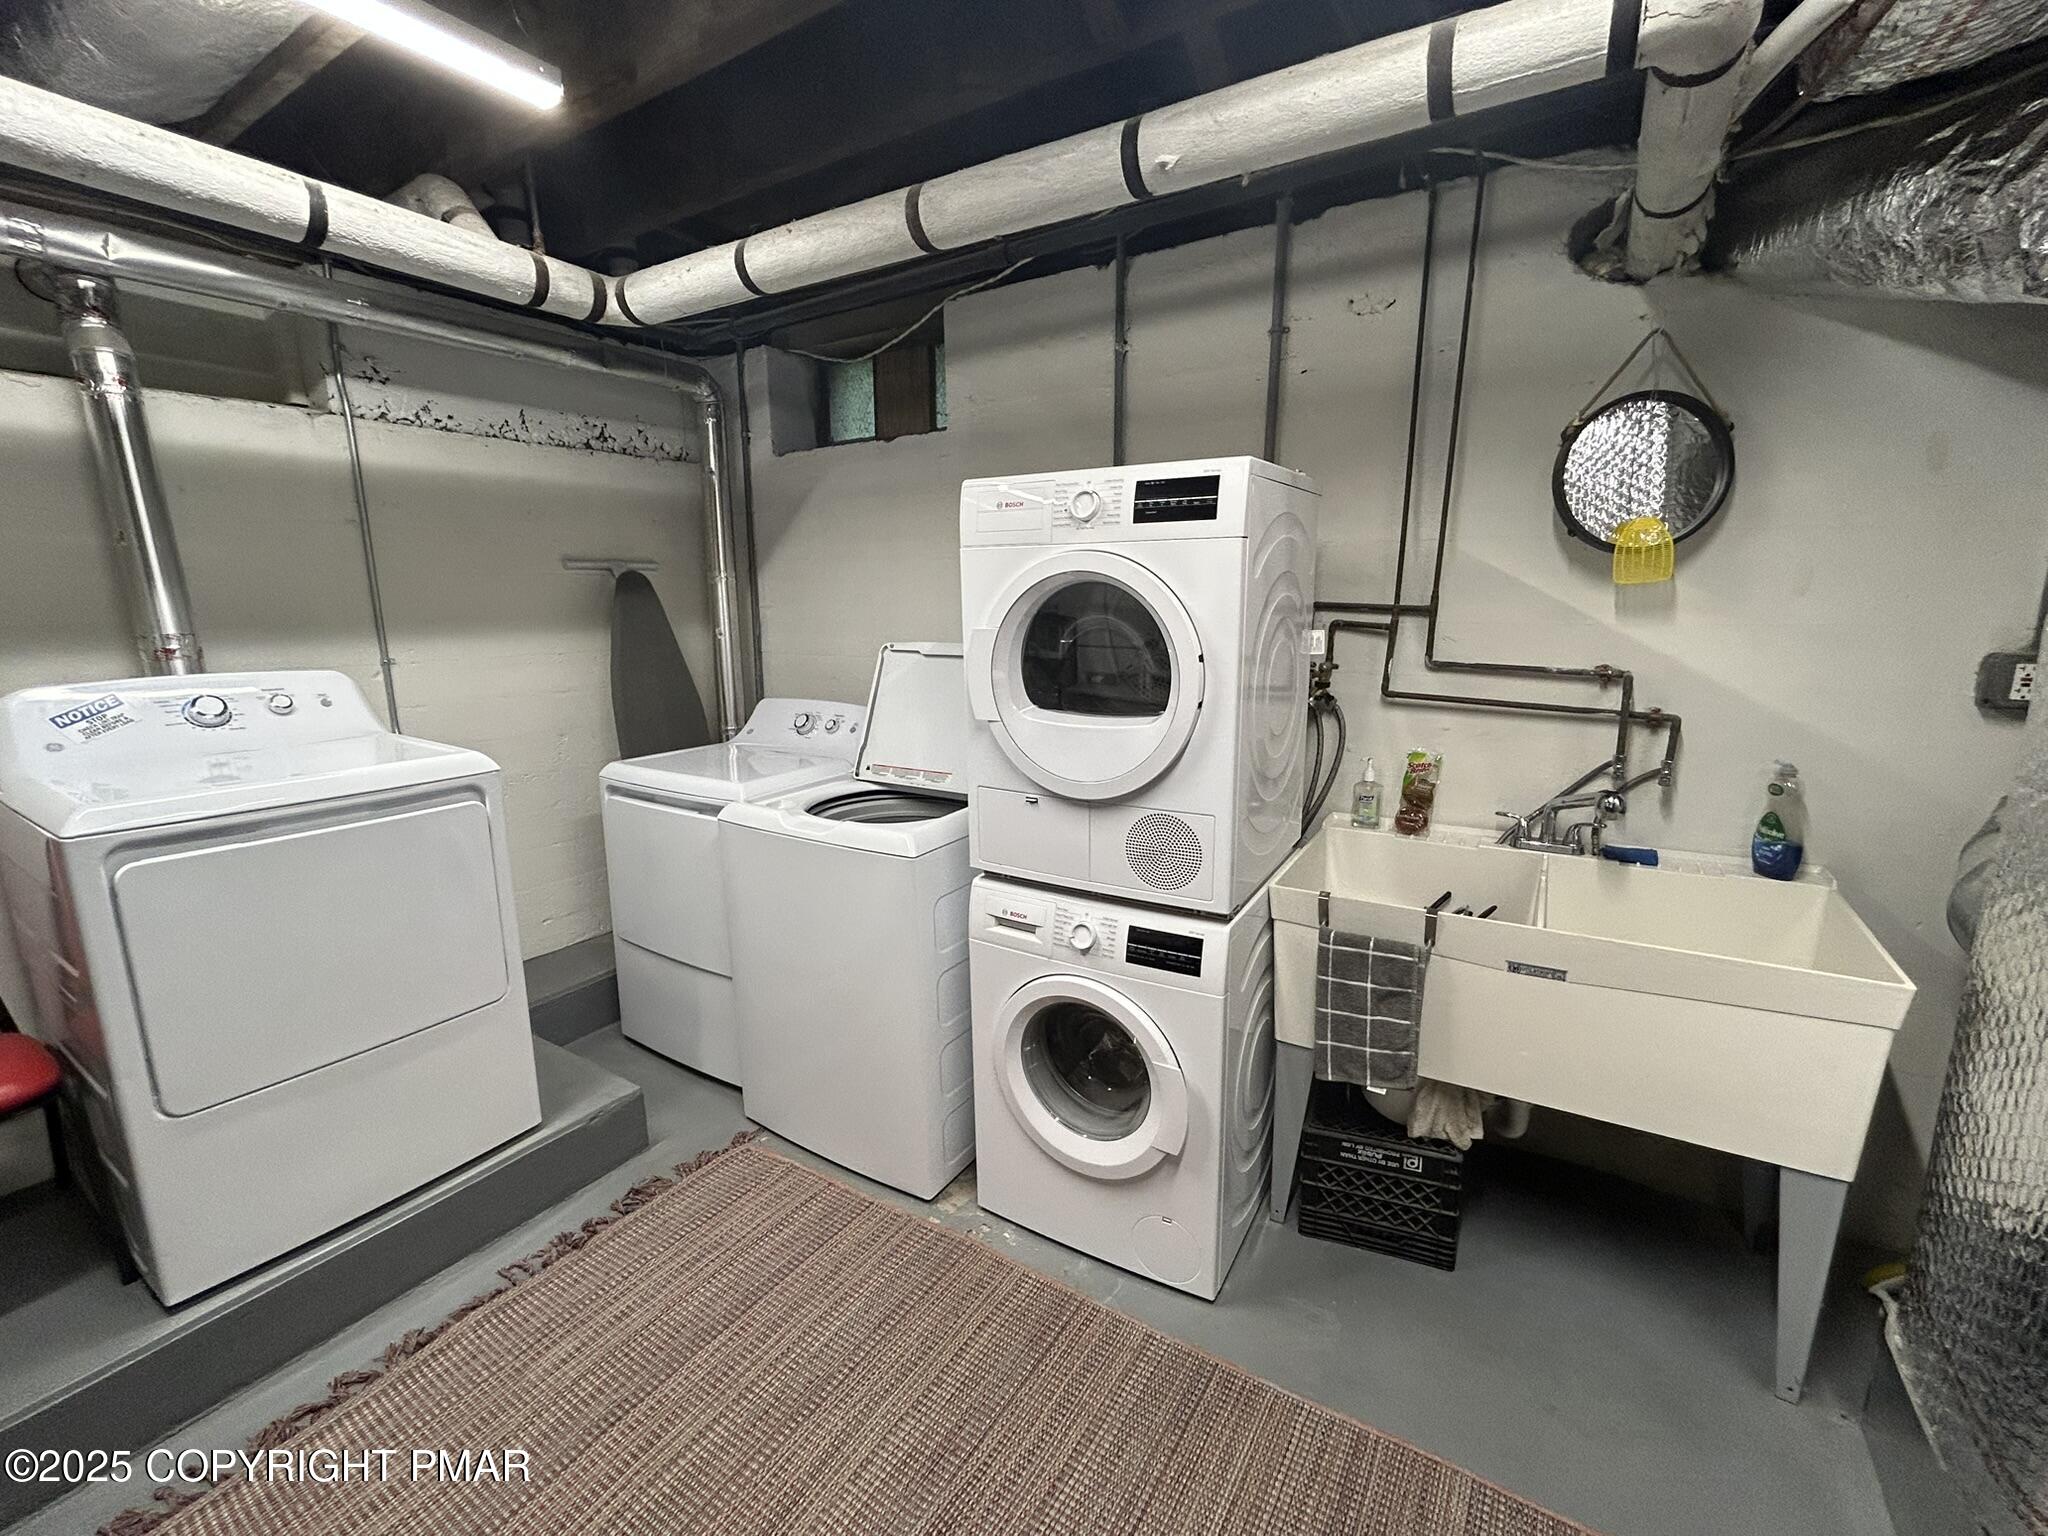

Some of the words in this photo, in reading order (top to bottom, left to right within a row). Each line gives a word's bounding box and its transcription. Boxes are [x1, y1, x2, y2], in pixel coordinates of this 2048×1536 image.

[54, 695, 119, 727] NOTICE
[85, 713, 108, 725] STOP
[1010, 911, 1027, 919] BOSCH
